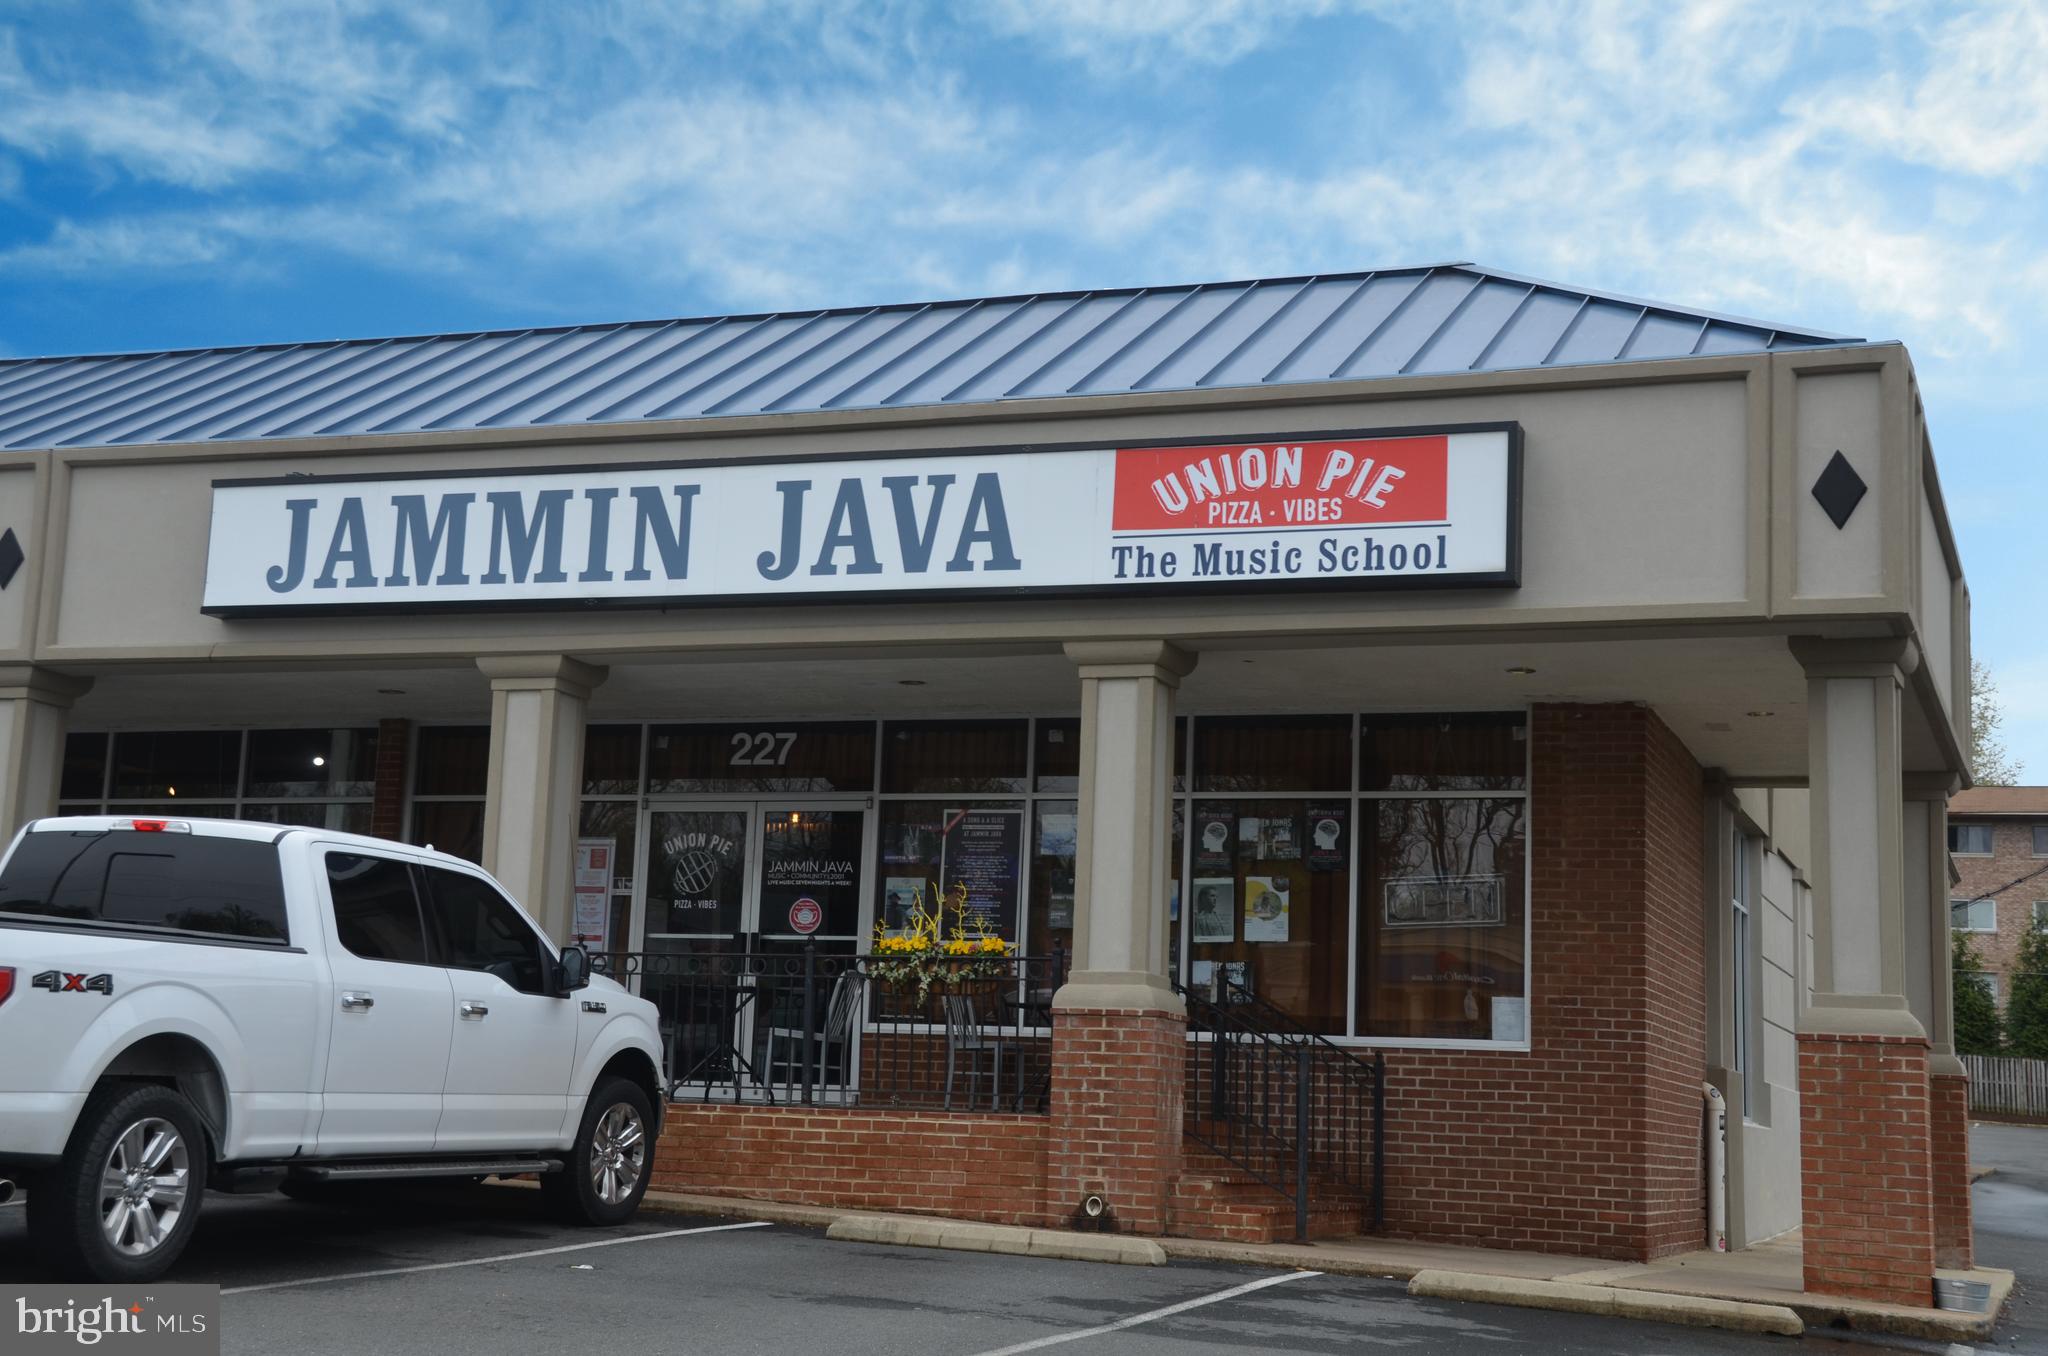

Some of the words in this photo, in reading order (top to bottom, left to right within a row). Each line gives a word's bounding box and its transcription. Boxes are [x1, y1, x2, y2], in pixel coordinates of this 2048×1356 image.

[1151, 446, 1303, 516] UNION
[1316, 448, 1406, 510] PIE
[1207, 500, 1263, 525] PIZZA
[1283, 497, 1343, 522] VIBES
[265, 483, 701, 594] JAMMIN
[755, 471, 1022, 582] JAVA
[1111, 544, 1178, 579] The
[1192, 539, 1302, 577] Music
[1317, 534, 1448, 573] School
[729, 731, 798, 766] 227
[664, 832, 706, 854] UNION
[710, 834, 734, 856] PIE
[768, 860, 819, 873] JAMMIN
[821, 860, 854, 873] JAVA
[673, 899, 692, 909] PIZZA
[697, 899, 718, 909] VIBES
